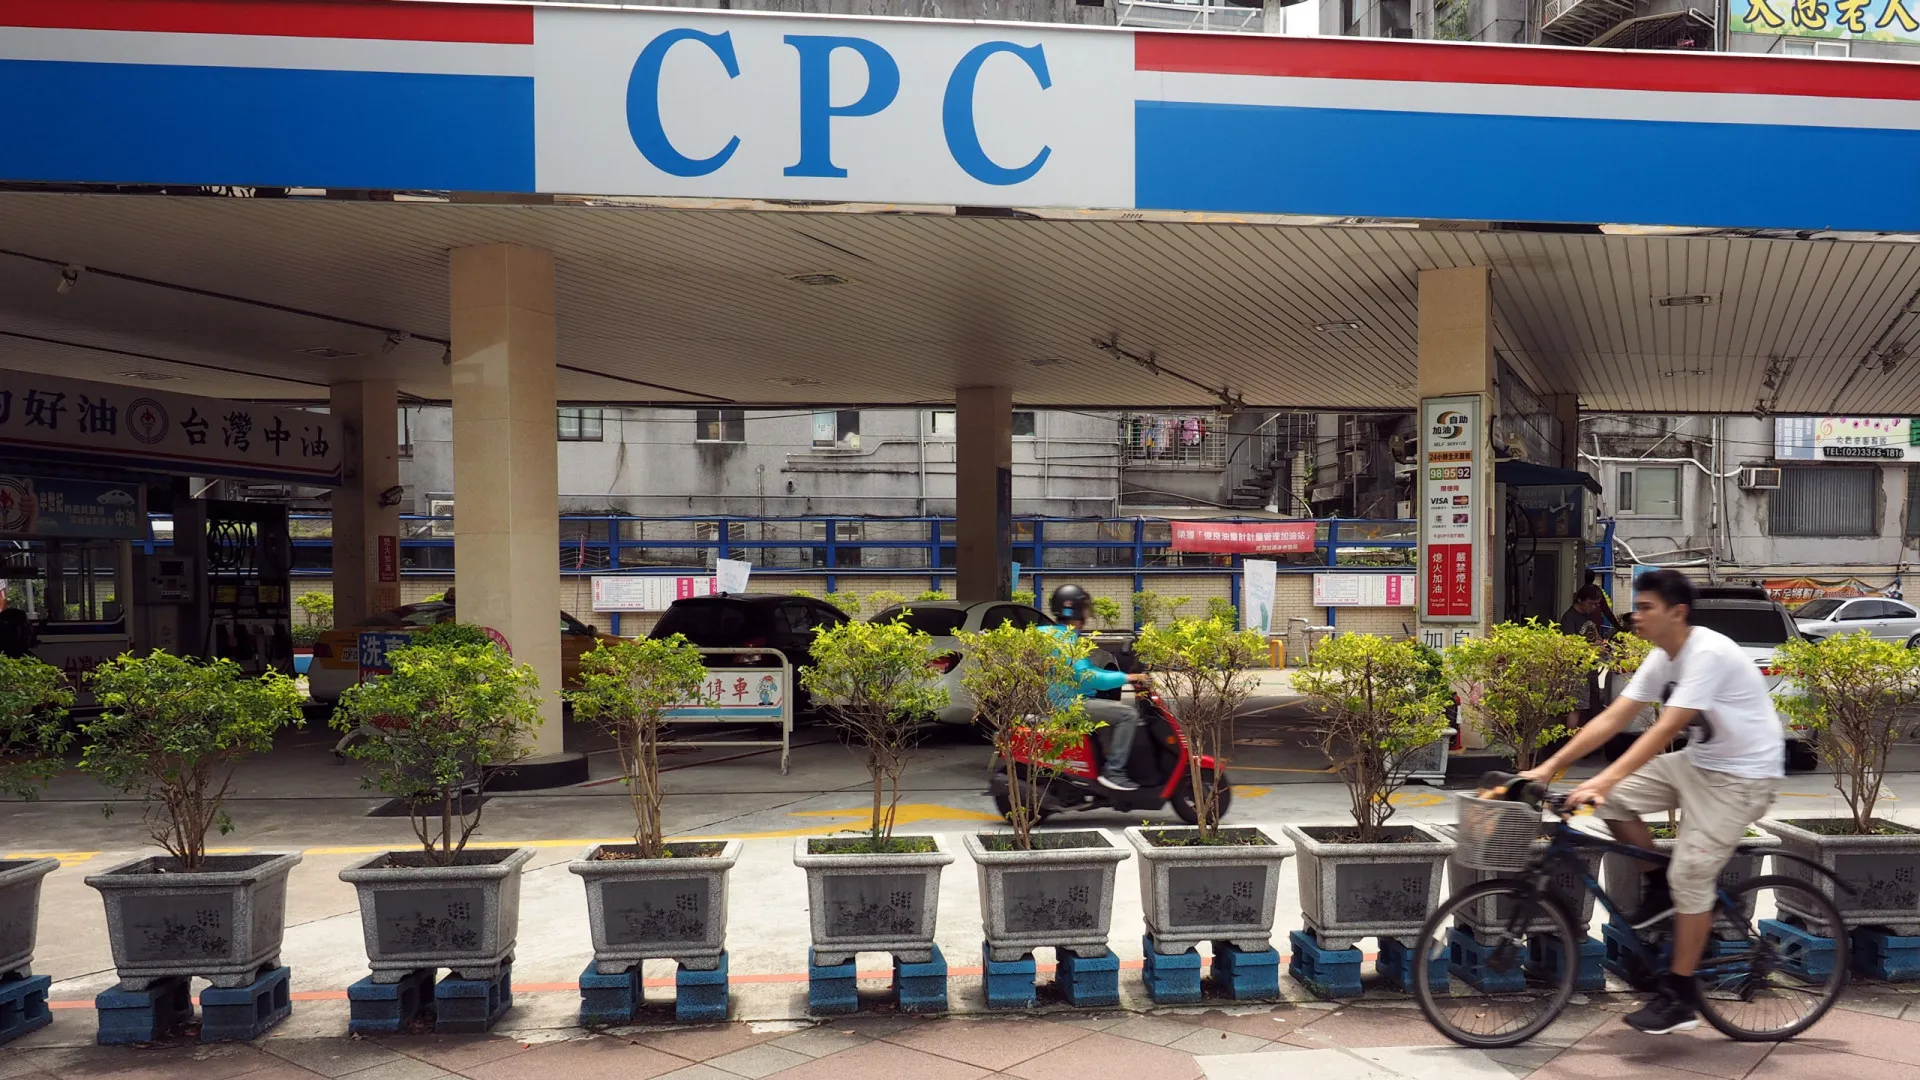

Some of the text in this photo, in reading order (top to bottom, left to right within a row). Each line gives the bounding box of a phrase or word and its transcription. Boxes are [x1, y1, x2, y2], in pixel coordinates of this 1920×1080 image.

[626, 28, 1053, 186] CPC
[1449, 415, 1469, 424] 自助
[180, 407, 329, 458] 台灣中油
[1432, 426, 1452, 435] 加油
[1430, 468, 1470, 478] 98 95 92
[1430, 497, 1448, 505] VISA
[1432, 552, 1443, 594] 熄火加油
[1455, 551, 1466, 594] 嚴禁煙火
[1766, 587, 1824, 599] 不足將罰款
[1423, 630, 1443, 649] 加
